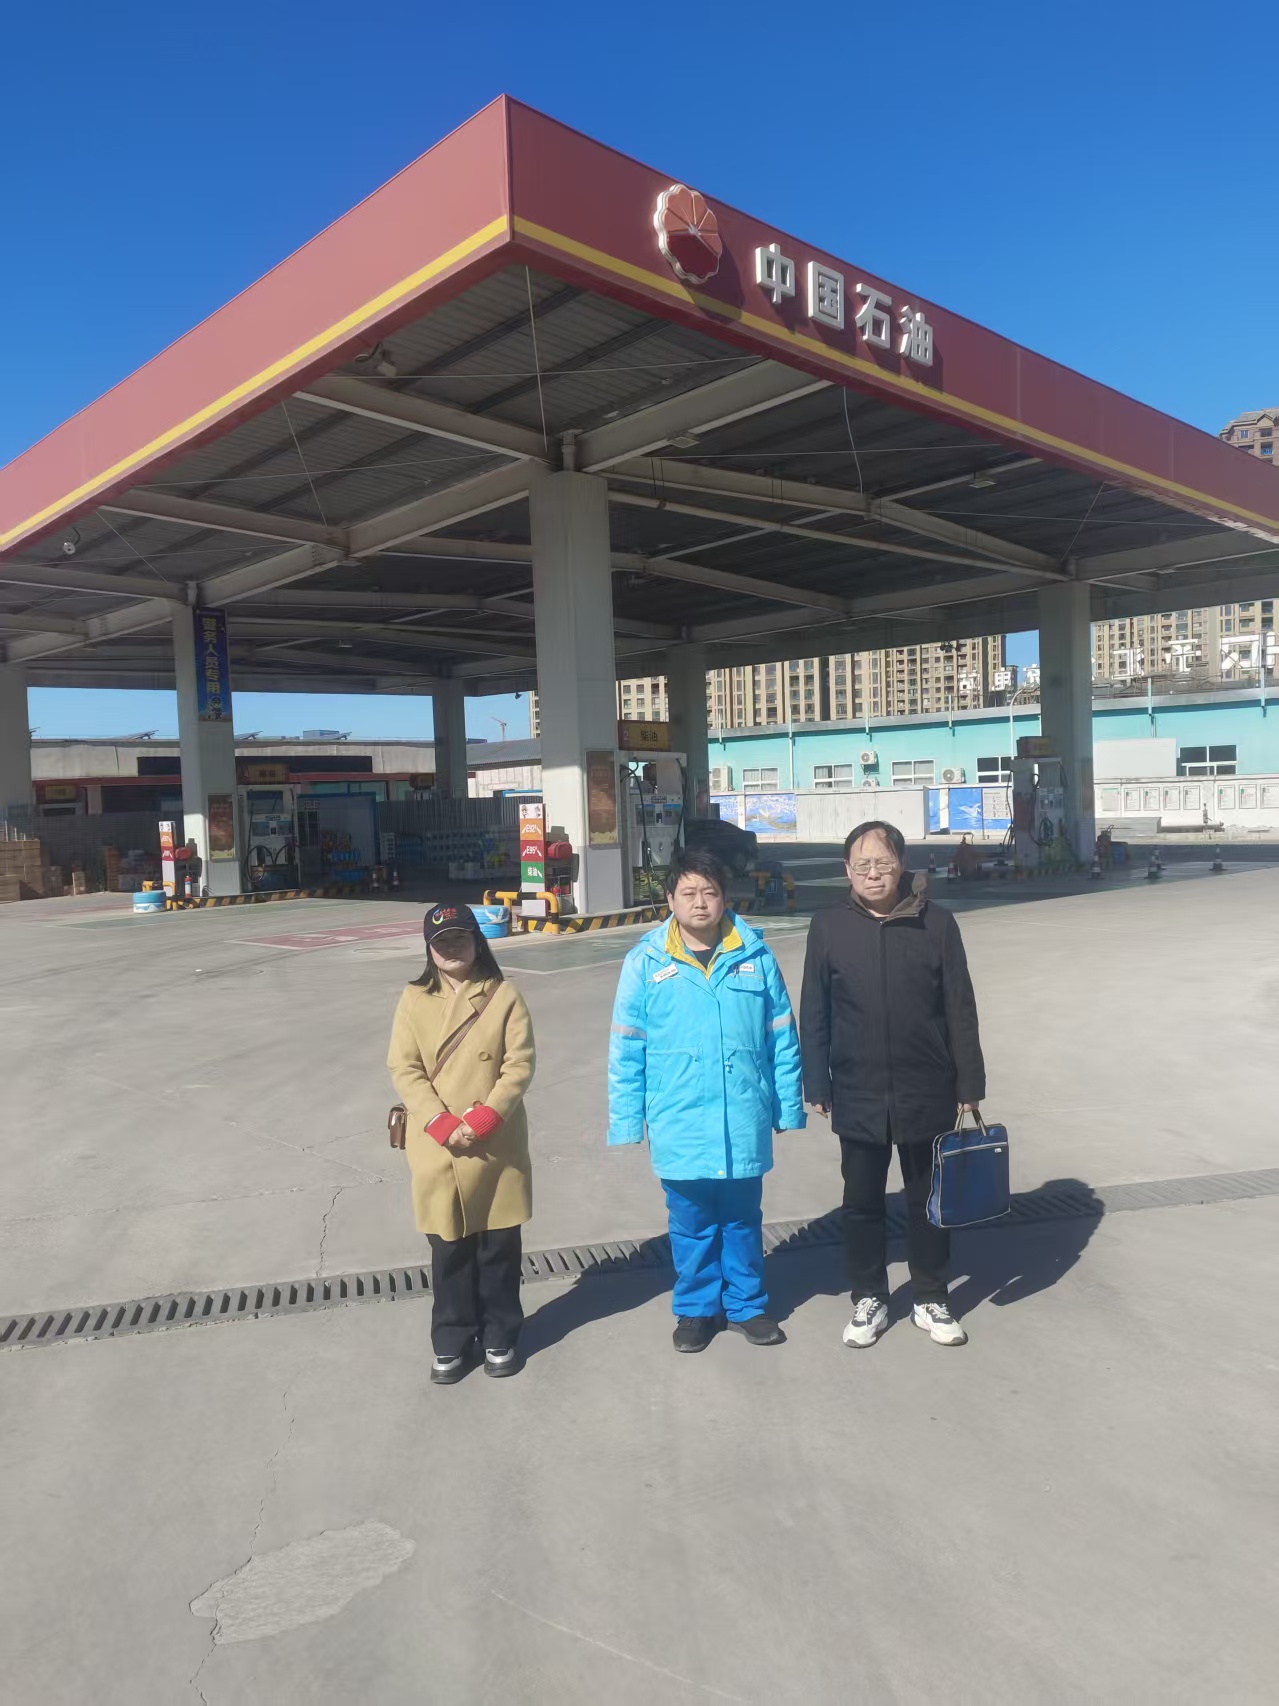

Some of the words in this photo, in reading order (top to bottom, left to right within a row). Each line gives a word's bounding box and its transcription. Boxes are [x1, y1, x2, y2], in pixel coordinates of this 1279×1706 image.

[755, 243, 933, 367] 中国石油
[202, 616, 221, 694] 警务人员专用
